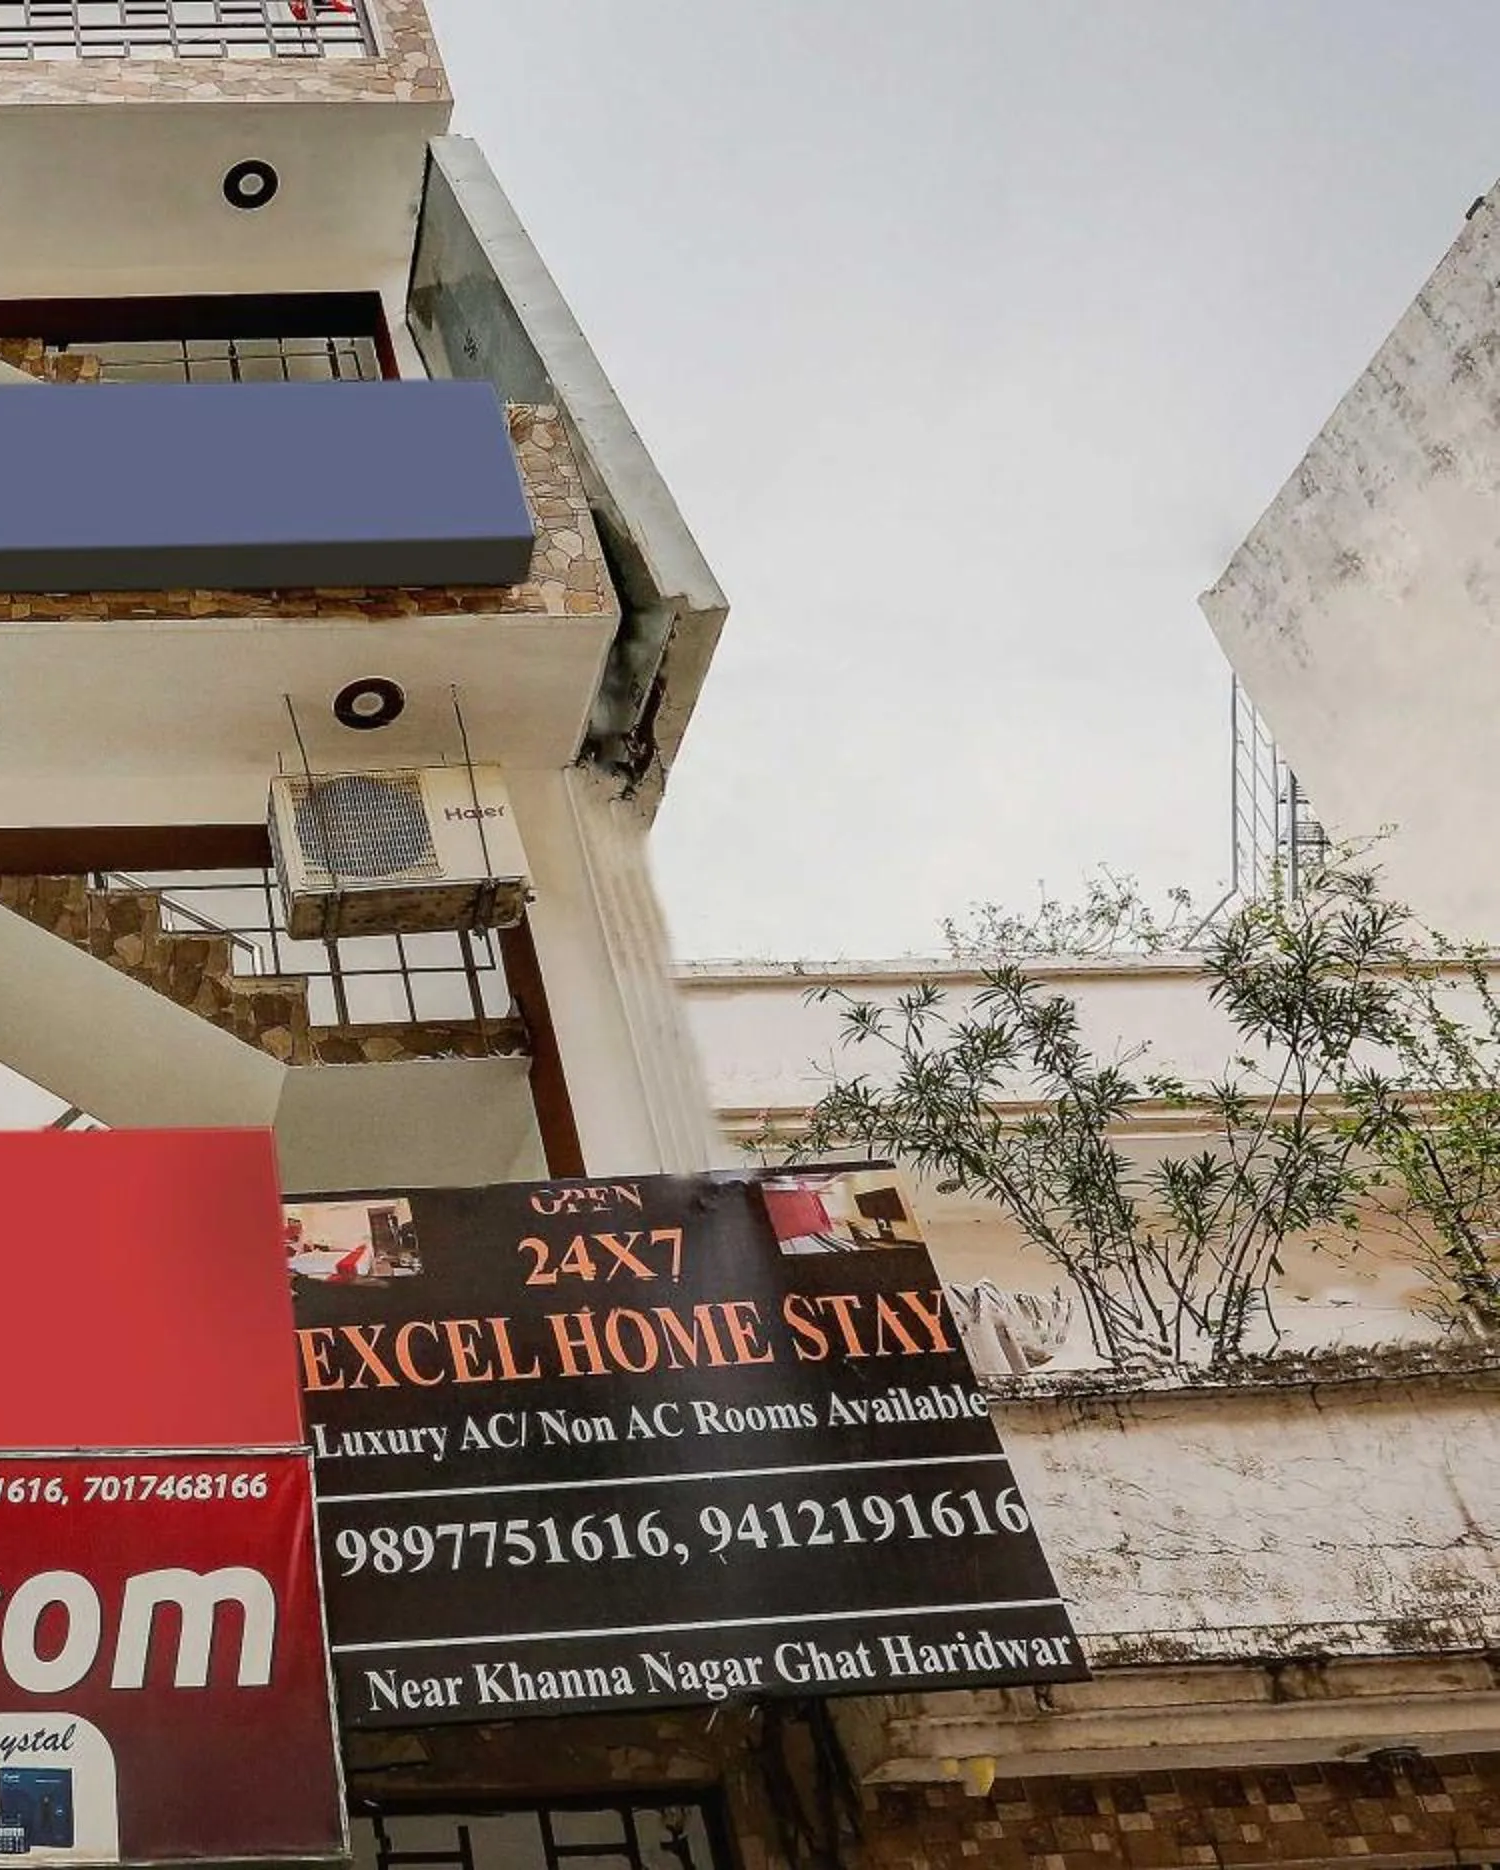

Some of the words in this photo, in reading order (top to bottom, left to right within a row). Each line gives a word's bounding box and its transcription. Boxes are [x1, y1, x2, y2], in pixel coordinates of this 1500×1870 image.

[444, 805, 504, 821] Haier
[517, 1227, 684, 1286] 24X7
[294, 1318, 540, 1392] EXCEL
[546, 1302, 774, 1376] HOME
[782, 1289, 957, 1361] STAY
[312, 1422, 449, 1461] Luxury
[460, 1410, 530, 1450] AC/
[536, 1409, 617, 1446] Non
[624, 1400, 682, 1440] AC
[690, 1398, 818, 1436] Rooms
[827, 1383, 990, 1427] Available
[82, 1472, 268, 1502] 7017468166
[334, 1509, 690, 1577] 9897751616,
[700, 1486, 1030, 1552] 9412191616
[365, 1669, 464, 1711] Near
[473, 1660, 636, 1703] Khanna
[638, 1650, 766, 1700] Nagar
[774, 1638, 875, 1684] Ghat
[879, 1630, 1073, 1676] Haridwar
